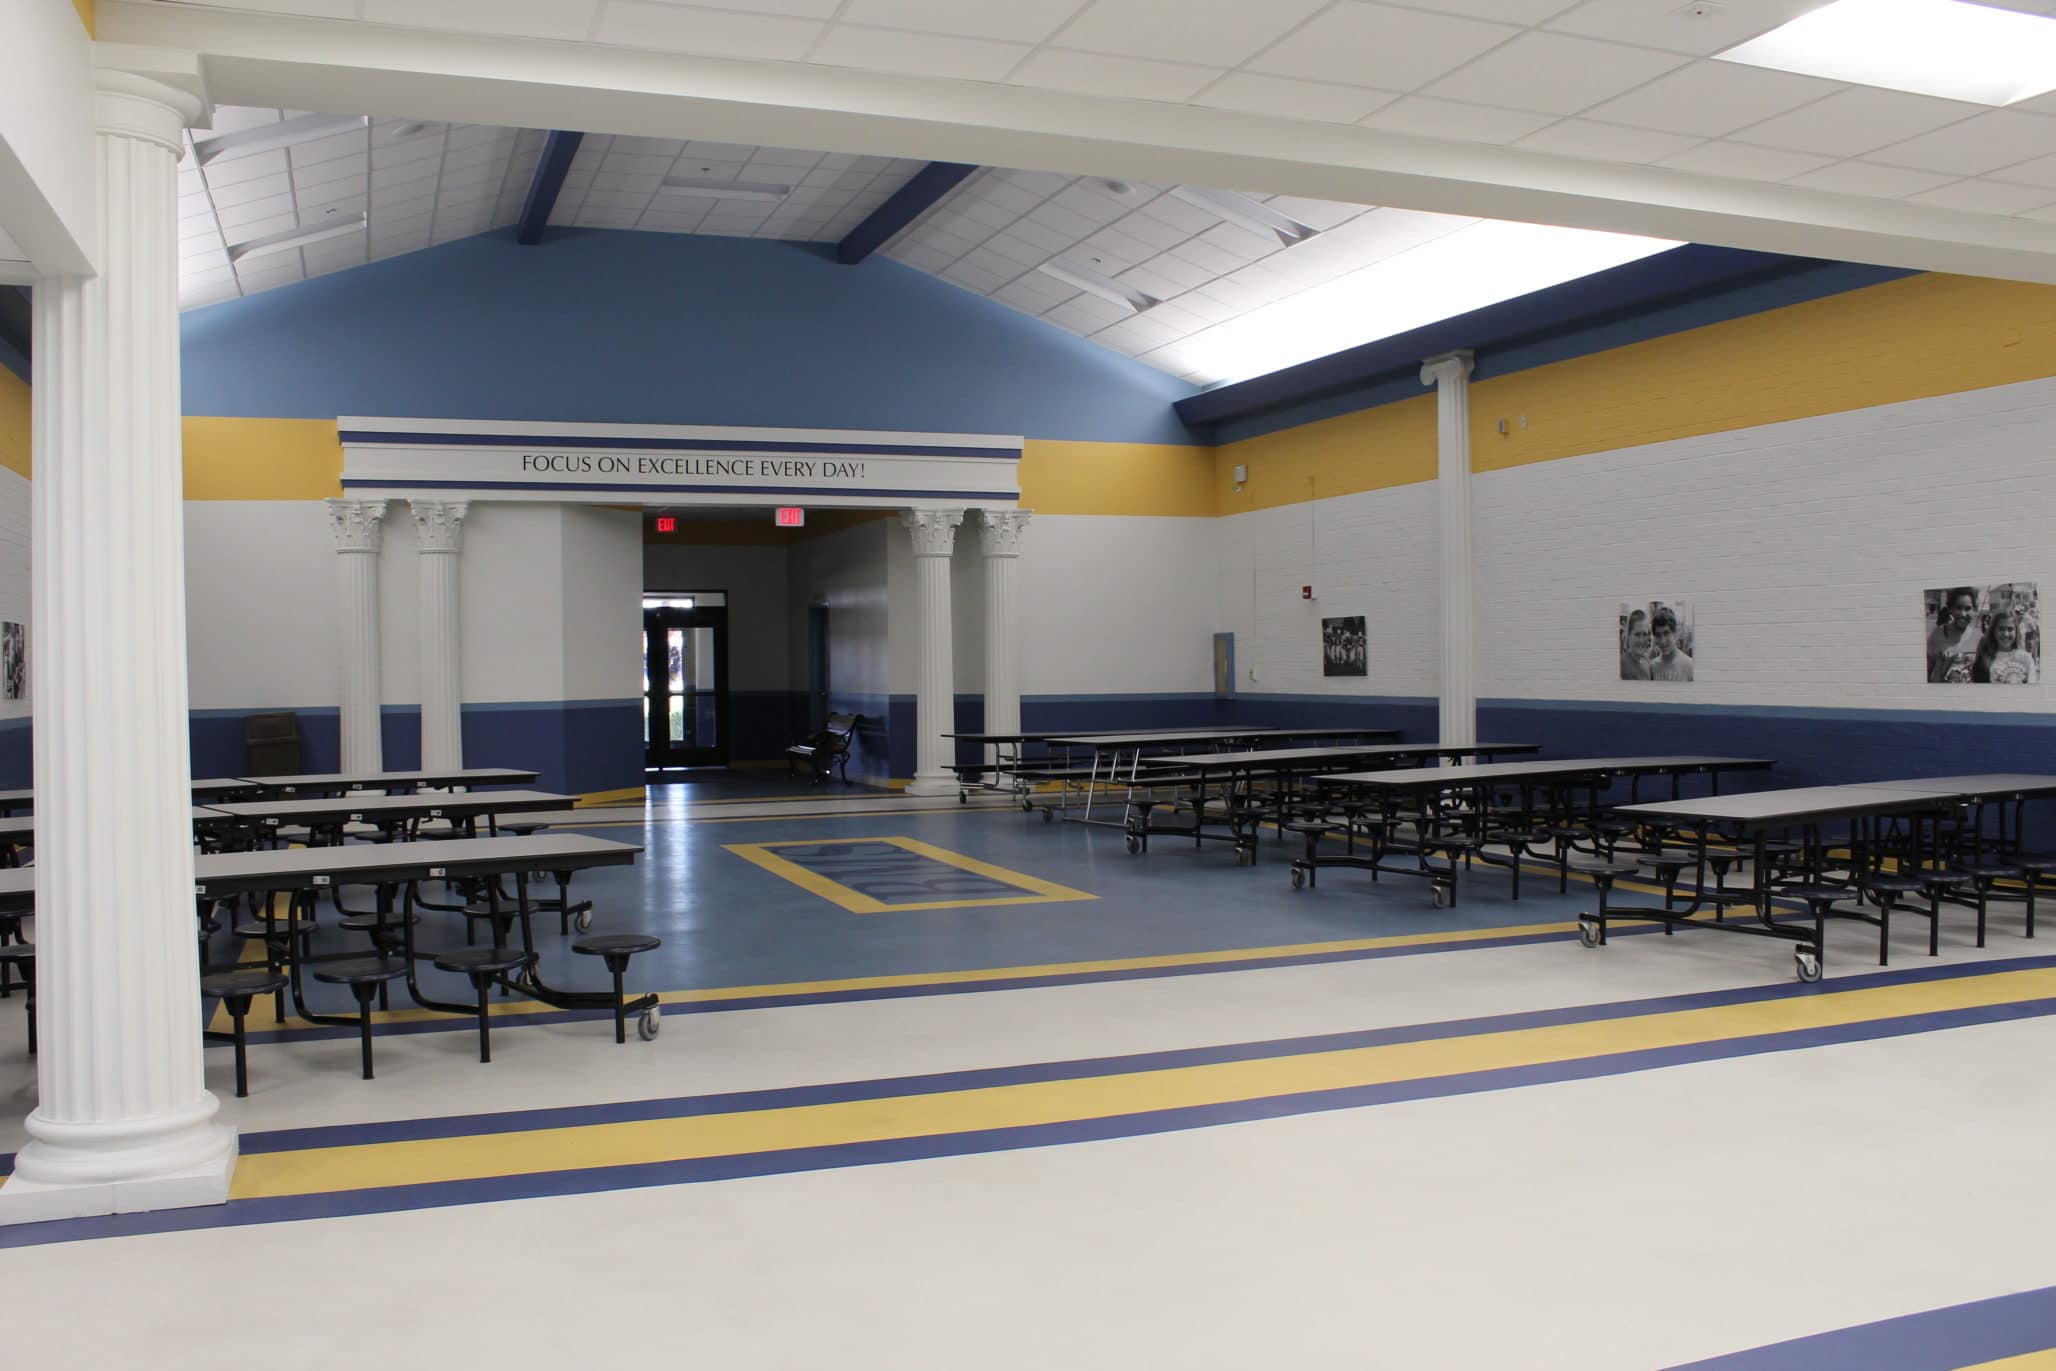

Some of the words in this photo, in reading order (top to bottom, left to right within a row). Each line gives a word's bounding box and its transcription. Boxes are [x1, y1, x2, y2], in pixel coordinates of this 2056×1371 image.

[522, 455, 592, 472] FOCUS
[598, 456, 630, 473] ON
[638, 457, 754, 475] EXCELLENCE
[761, 460, 816, 477] EVERY
[823, 462, 865, 478] DAY!
[658, 518, 675, 532] EXIT
[780, 507, 801, 525] EXIT
